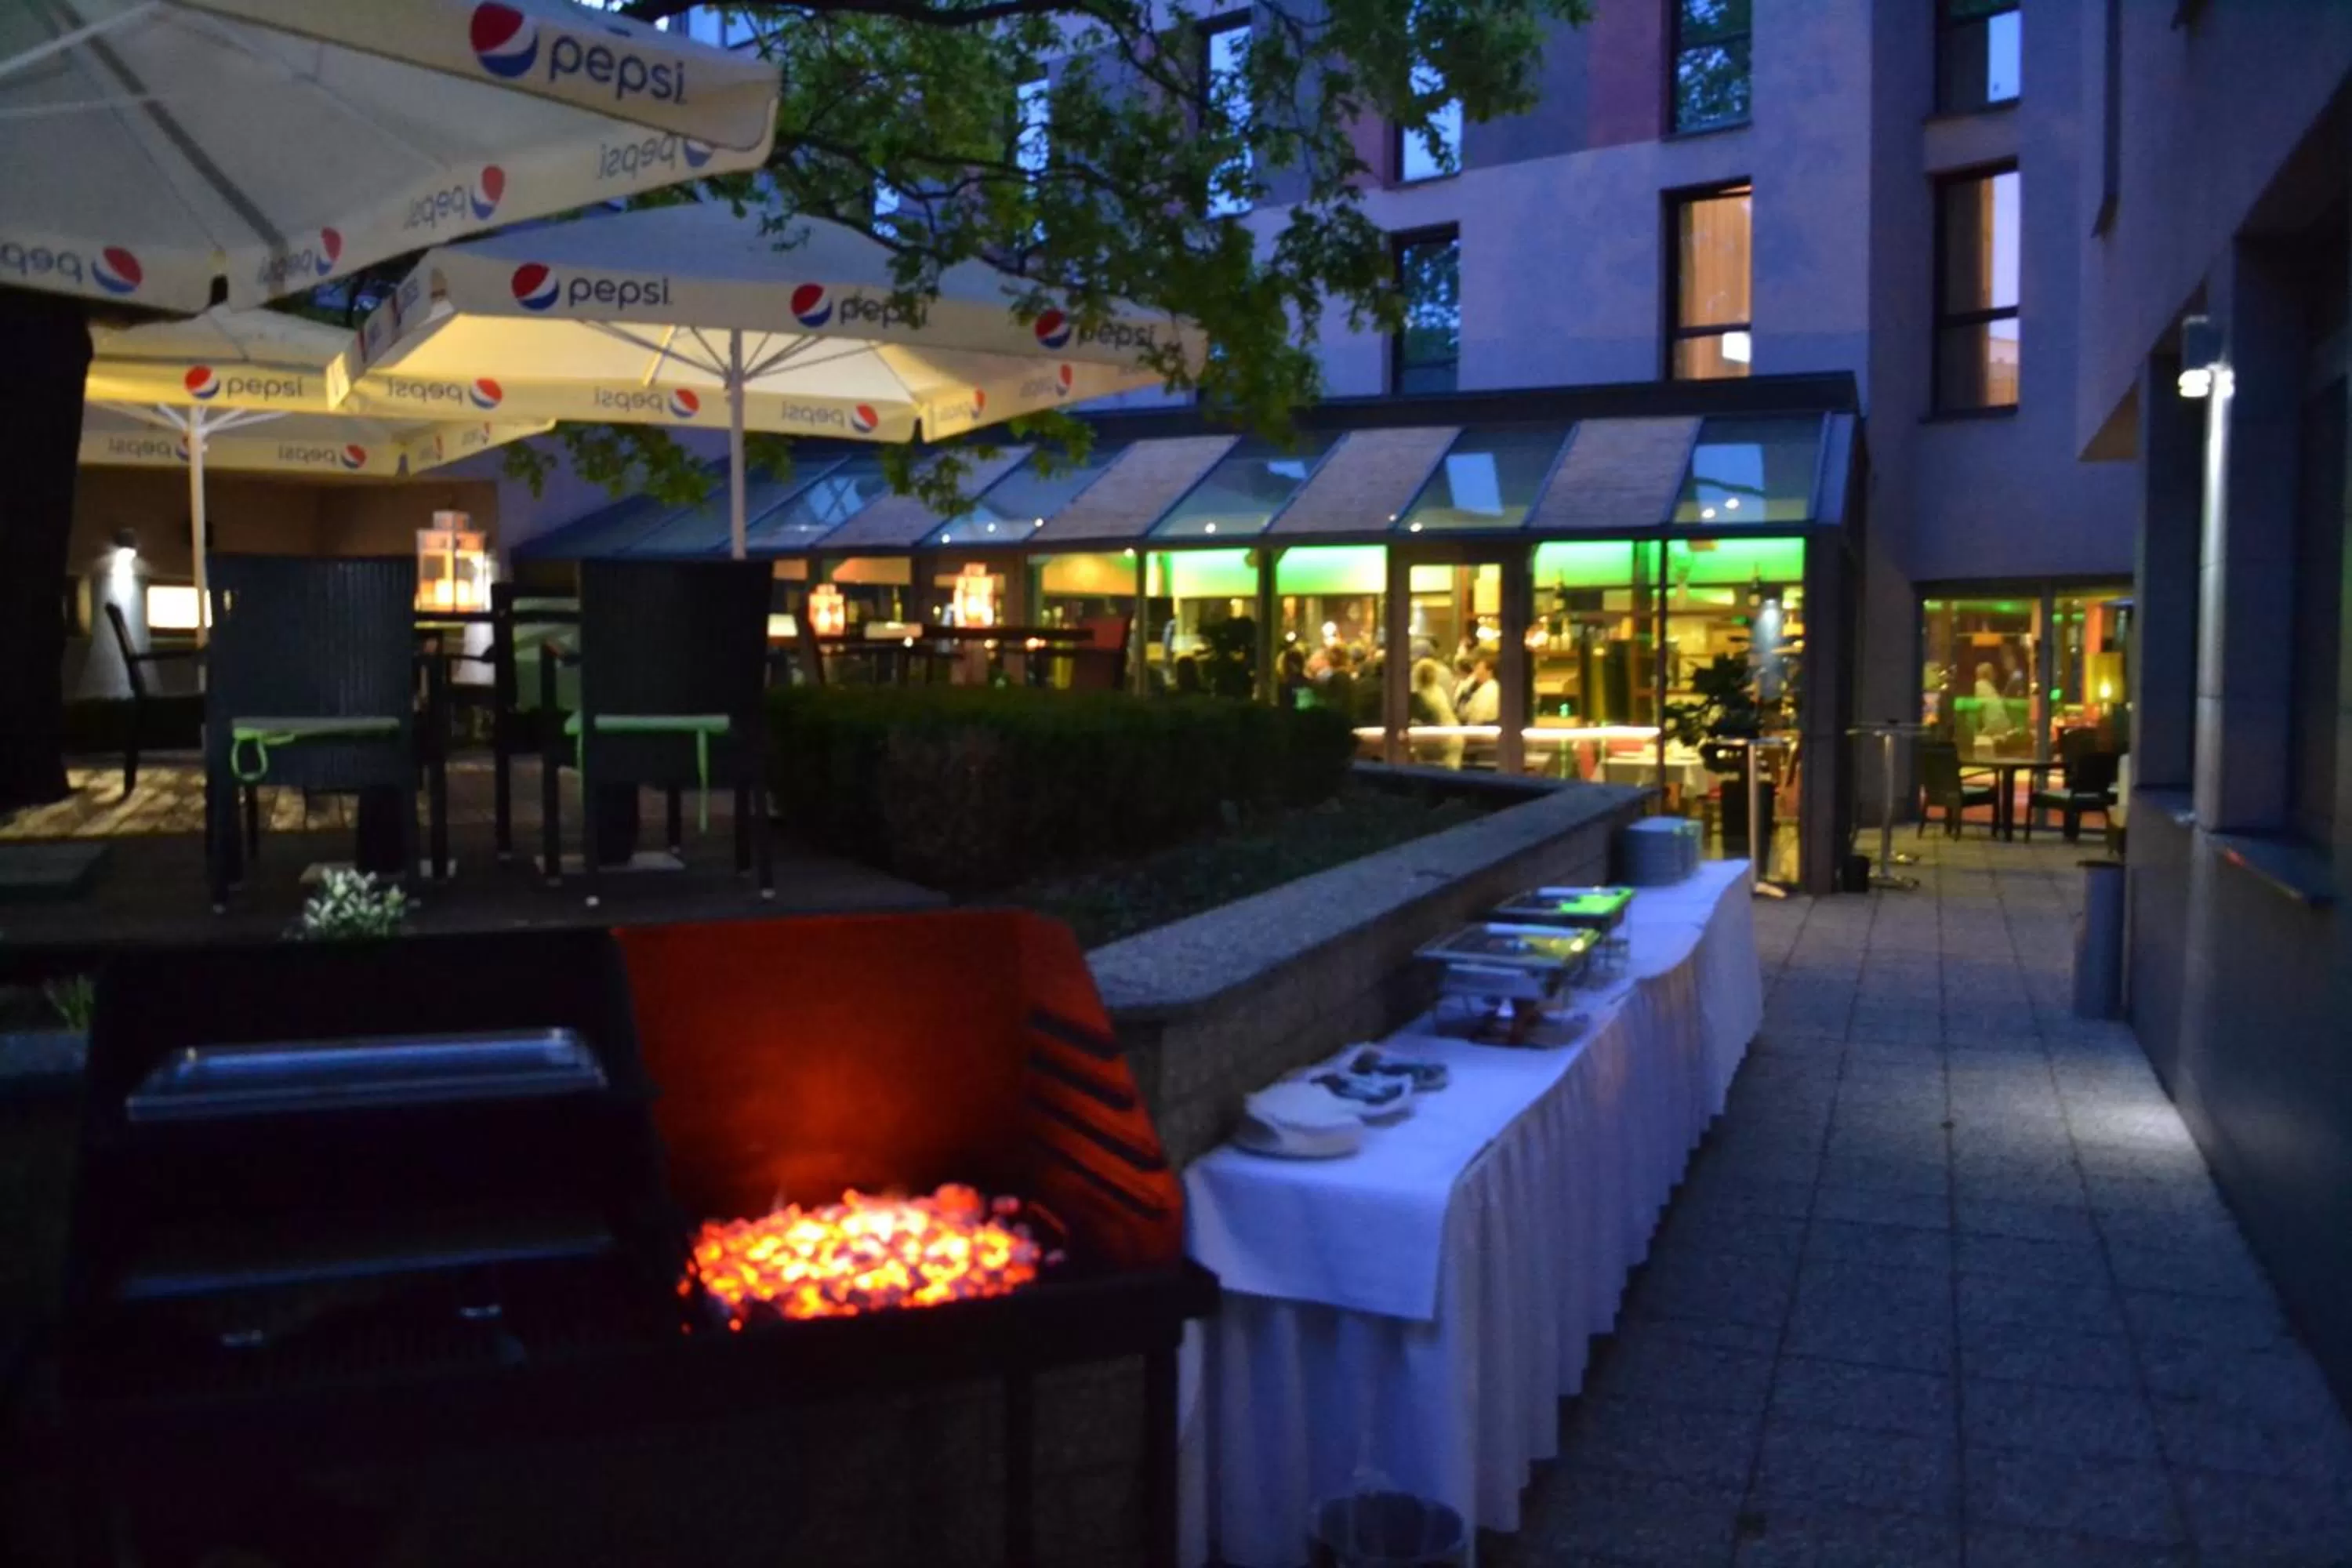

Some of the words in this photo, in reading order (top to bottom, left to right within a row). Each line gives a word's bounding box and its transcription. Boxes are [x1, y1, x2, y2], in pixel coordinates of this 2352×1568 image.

[550, 35, 687, 103] pepsi
[568, 276, 673, 310] pepsi
[227, 376, 303, 401] pepsi
